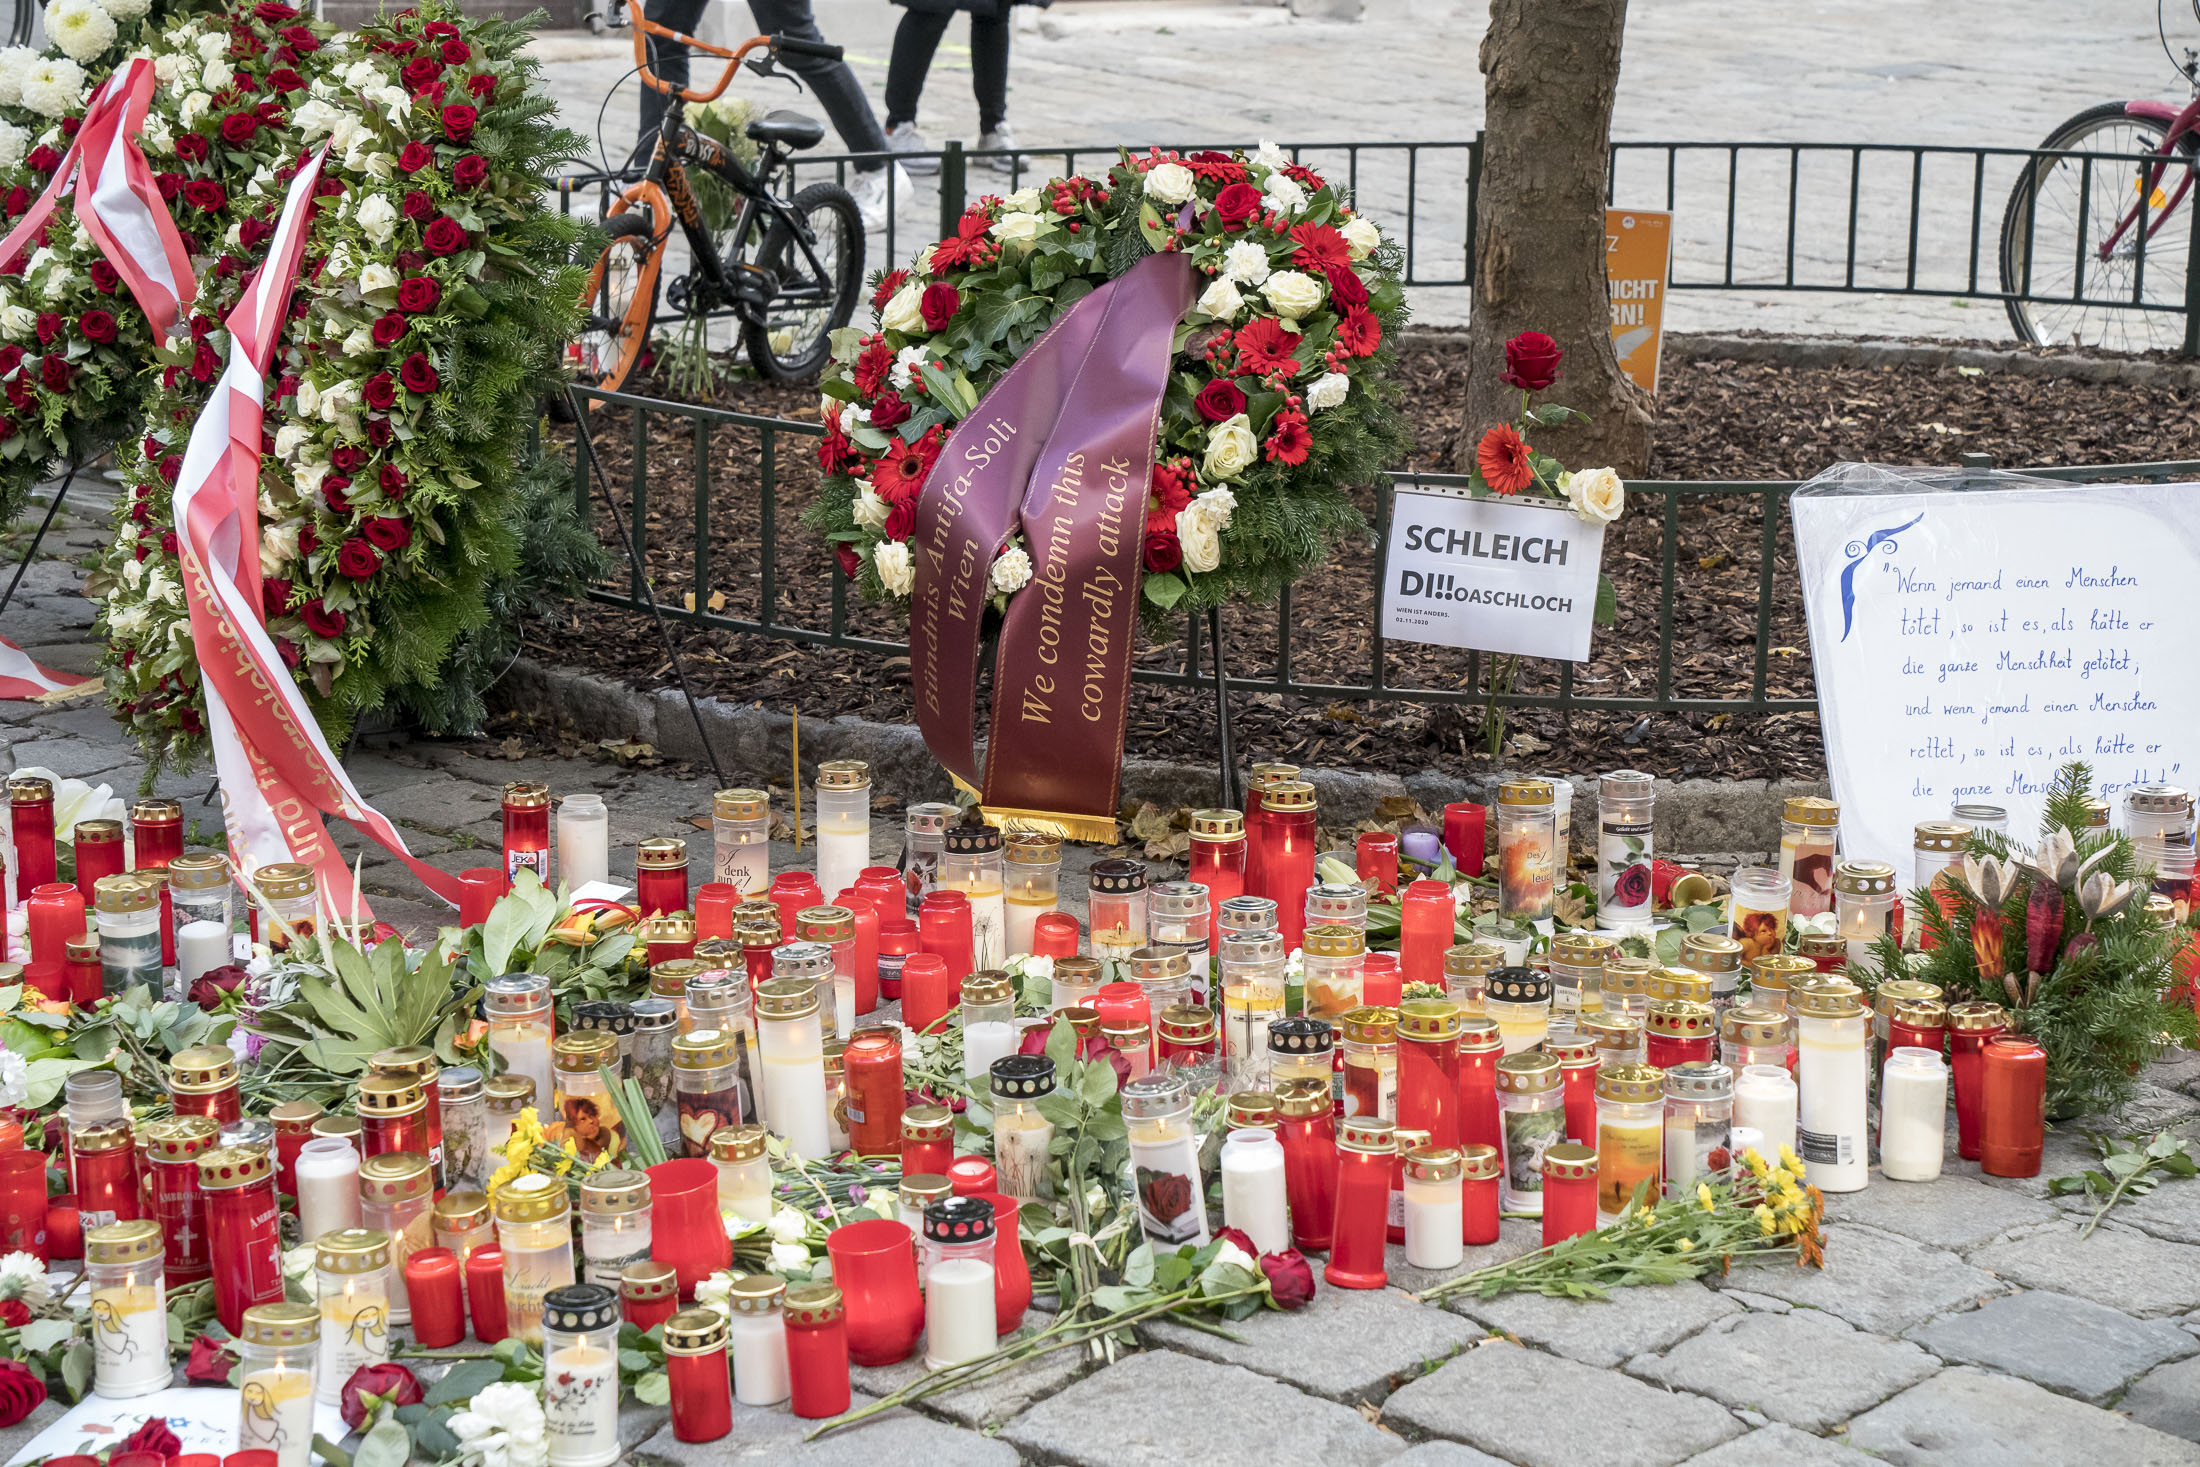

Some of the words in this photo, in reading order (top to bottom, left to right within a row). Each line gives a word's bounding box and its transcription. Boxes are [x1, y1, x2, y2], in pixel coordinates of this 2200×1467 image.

[926, 417, 1018, 576] Antifa-Soli
[1050, 451, 1086, 508] this
[1096, 454, 1131, 558] attack
[1404, 523, 1570, 567] SCHLEICH
[948, 538, 979, 624] Wien
[1034, 515, 1073, 665] condemn
[1946, 568, 2003, 601] jemand
[2015, 573, 2050, 589] einen
[2065, 565, 2139, 589] Menschen
[1395, 616, 1429, 626] 02.11.2020
[1413, 608, 1423, 616] IST
[1423, 610, 1450, 618] ANDERS.
[1961, 624, 1974, 633] so
[1988, 609, 2008, 633] ist
[2050, 607, 2074, 632] als
[2090, 607, 2130, 632] hätte
[2138, 622, 2155, 631] er
[920, 582, 941, 719] Bündnis
[1080, 565, 1124, 723] cowardly
[1901, 655, 1925, 675] die
[1938, 660, 1979, 683] ganze
[1996, 647, 2072, 672] Menschheit
[1021, 672, 1056, 726] We
[1905, 695, 1932, 716] und
[1943, 704, 1975, 716] wenn
[1981, 695, 2030, 725] jemand
[2043, 702, 2079, 713] einen
[2089, 690, 2158, 712] Menschen
[1974, 748, 1986, 757] so
[2000, 737, 2015, 757] ist
[2059, 735, 2083, 756] als
[2095, 731, 2136, 754] hätte
[2145, 743, 2163, 753] er
[1912, 777, 1934, 797] die
[1950, 785, 1993, 807] ganze
[724, 865, 750, 877] denk
[1532, 872, 1553, 883] leuc
